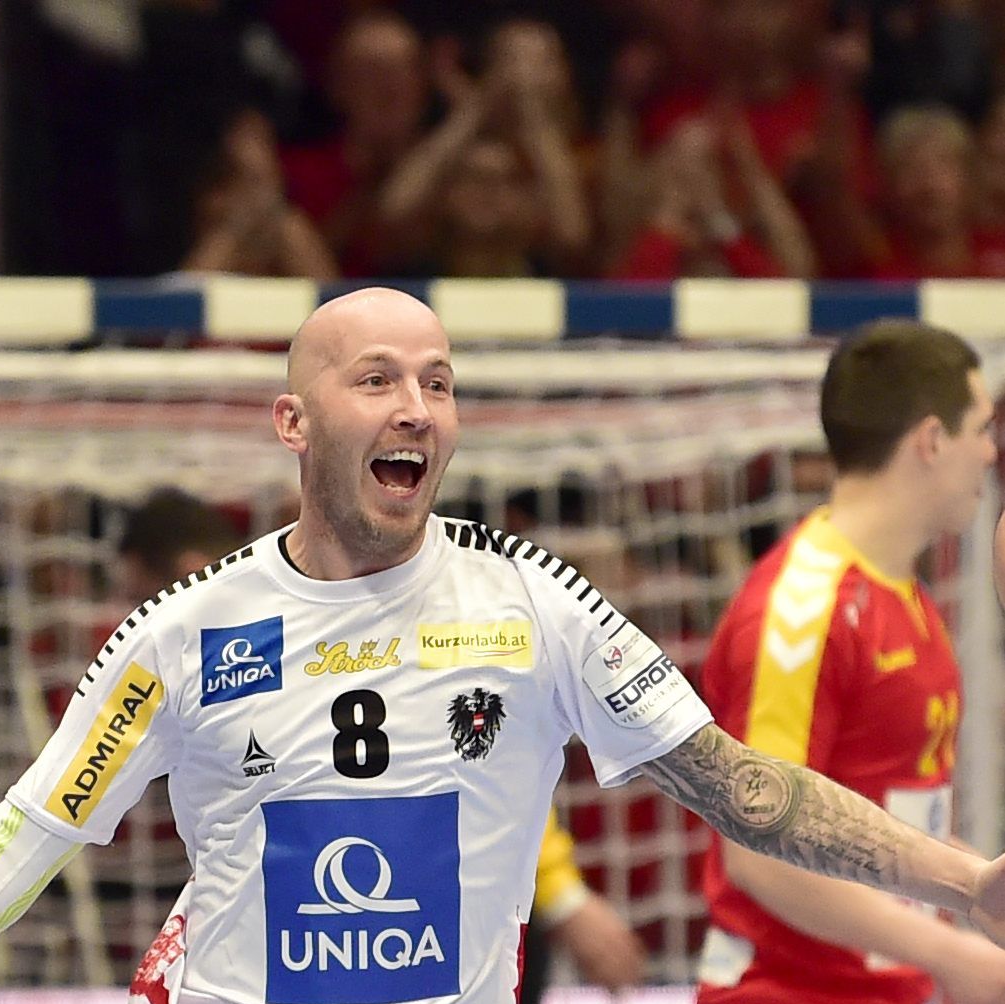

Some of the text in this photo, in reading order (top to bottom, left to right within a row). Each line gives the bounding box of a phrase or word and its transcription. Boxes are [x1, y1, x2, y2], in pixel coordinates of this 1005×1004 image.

[304, 637, 402, 676] Ströck
[421, 632, 528, 649] Kurzurlaub.at
[207, 664, 276, 693] UNIQA
[62, 681, 156, 821] ADMIRAL
[331, 689, 389, 779] 8
[280, 924, 445, 972] UNIQA
